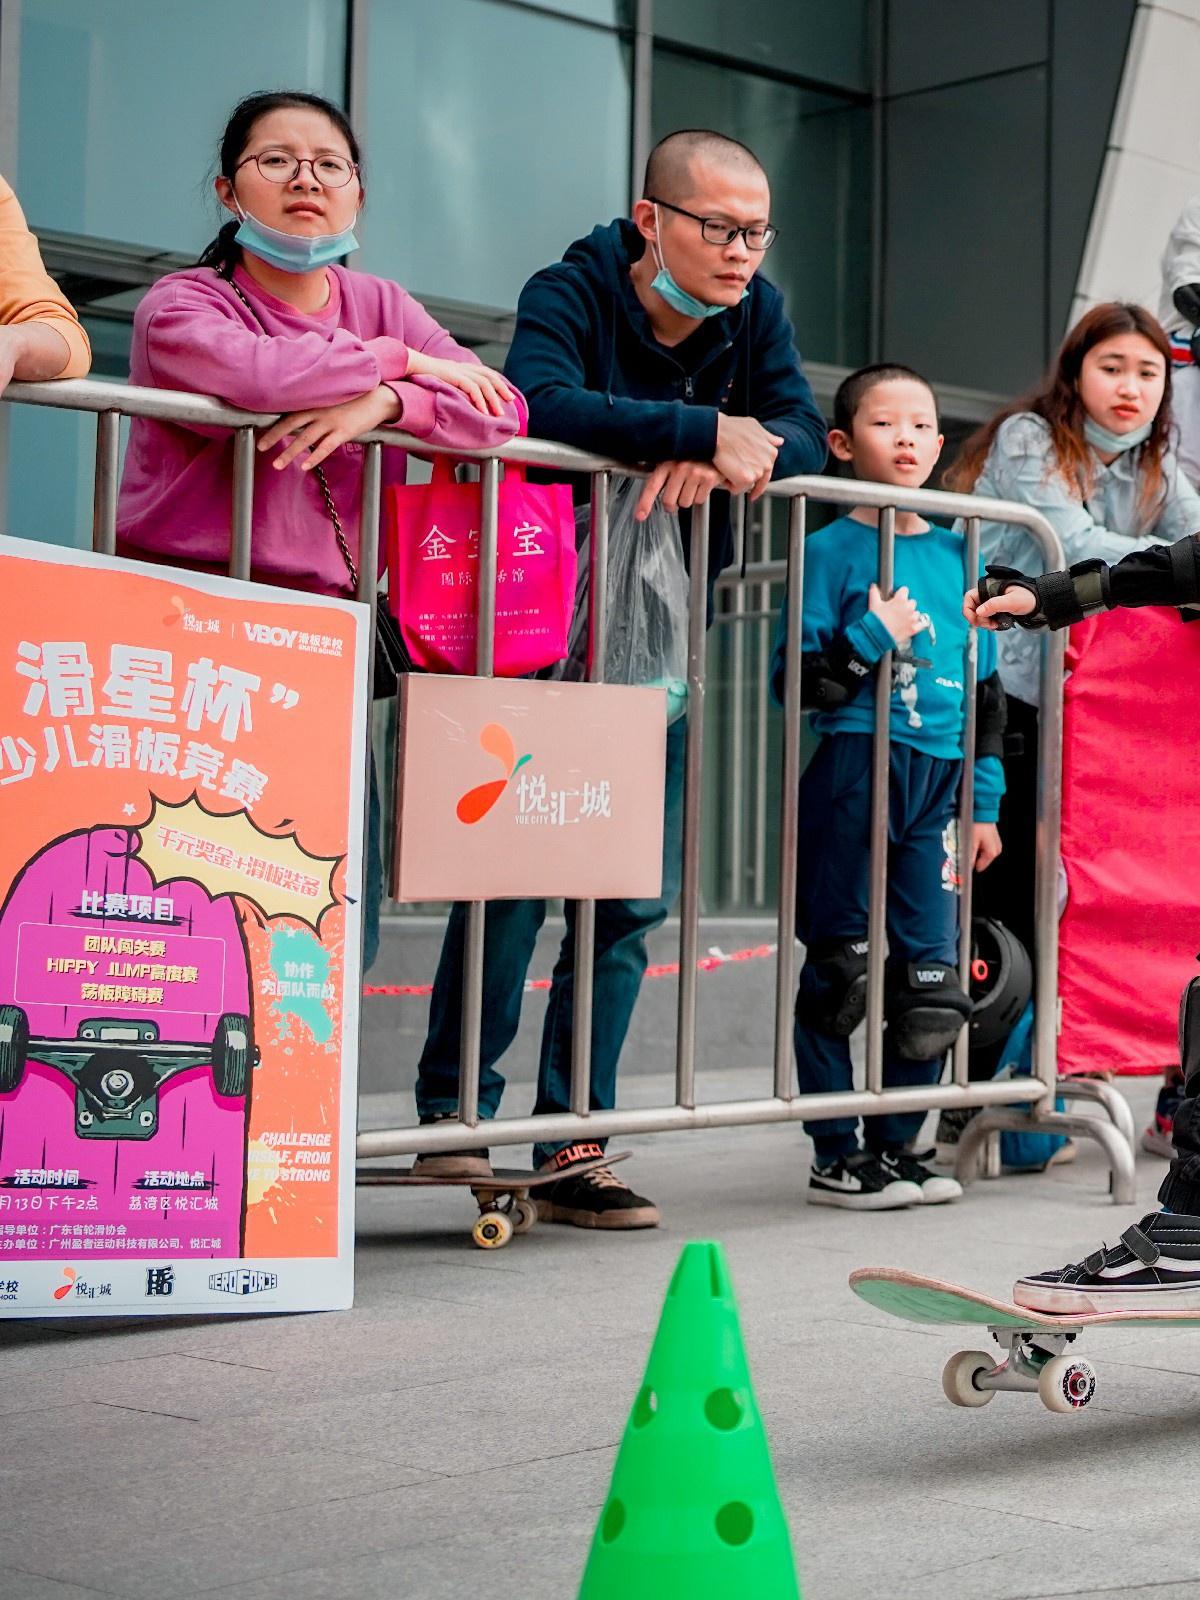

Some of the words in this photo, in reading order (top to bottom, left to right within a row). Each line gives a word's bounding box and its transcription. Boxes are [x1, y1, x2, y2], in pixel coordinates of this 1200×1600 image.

[418, 522, 545, 561] 金宝
[244, 622, 298, 648] VBOY
[0, 725, 268, 810] 少儿滑板竞赛
[516, 774, 611, 826] 悦汇城
[515, 815, 530, 825] YUE
[531, 815, 549, 825] CITY
[81, 890, 174, 921] 比赛项目
[84, 935, 167, 958] 团队闯关赛
[47, 958, 98, 975] HIPPY
[917, 970, 946, 983] VBOY
[81, 983, 164, 1004] 荡板障碍赛
[260, 1132, 332, 1146] CHALLENGE
[295, 1151, 332, 1165] FROM
[14, 1168, 80, 1186] 活动时间
[143, 1170, 205, 1188] 活动地点
[280, 1168, 331, 1182] STRONG
[128, 1195, 219, 1211] 荔湾区悦汇城
[75, 1282, 112, 1299] 悦汇城
